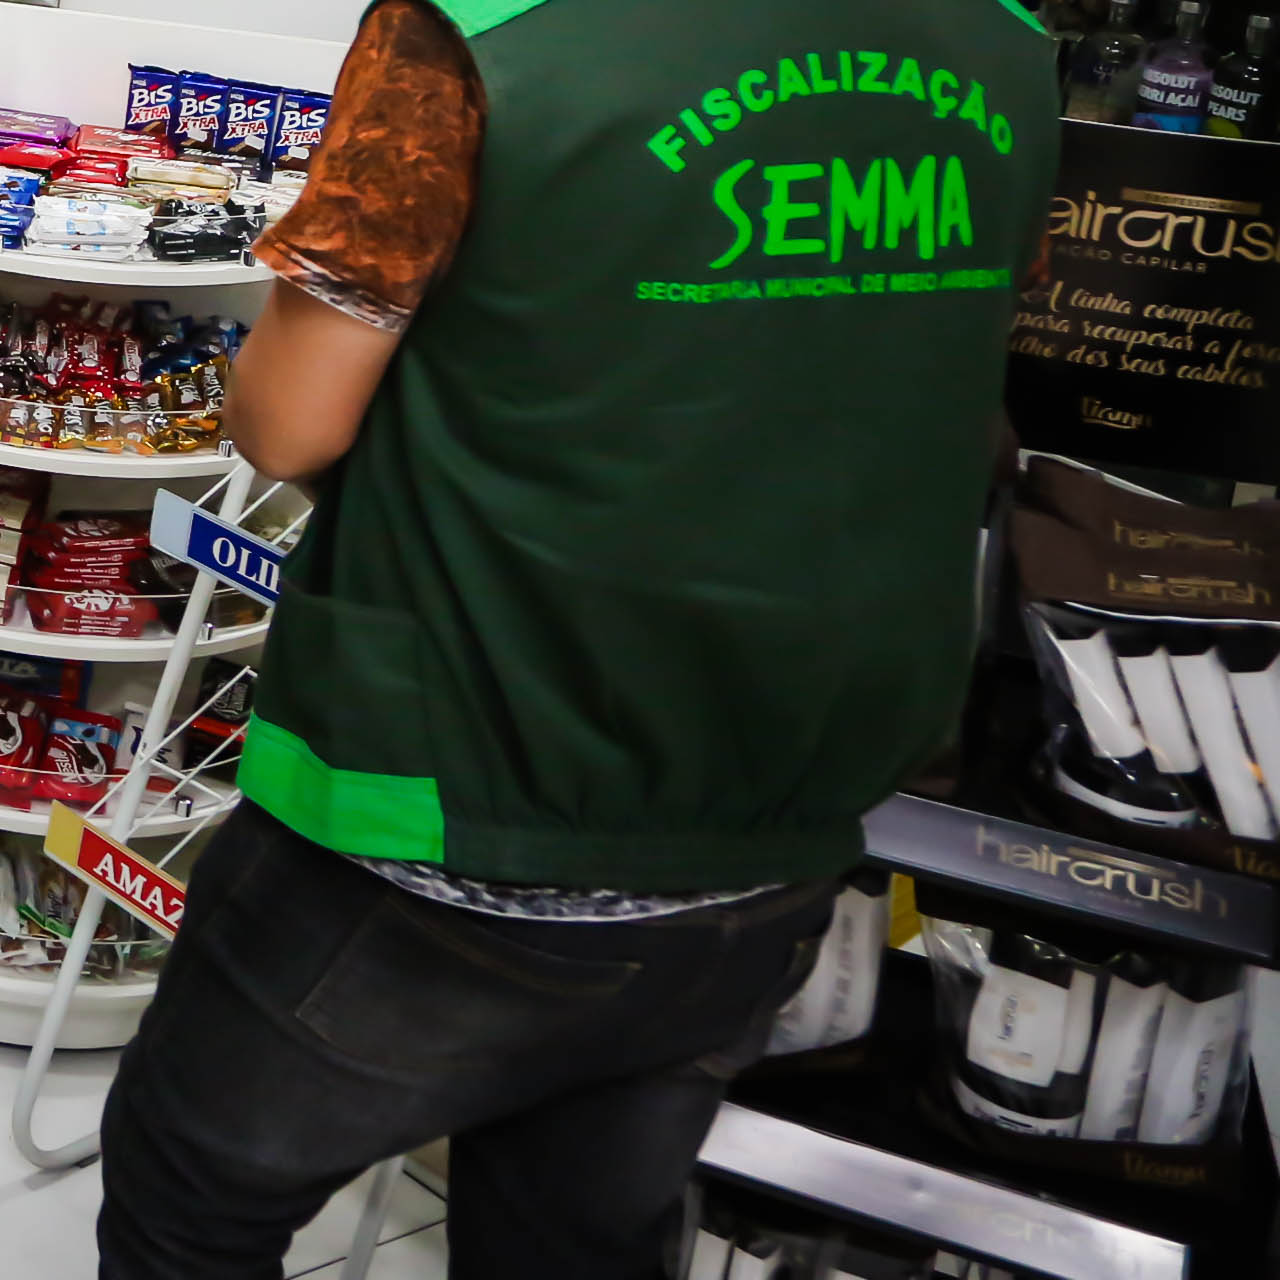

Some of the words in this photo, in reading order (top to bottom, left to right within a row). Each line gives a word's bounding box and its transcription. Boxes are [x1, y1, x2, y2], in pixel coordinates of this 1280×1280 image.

[1210, 82, 1261, 106] BSOLUT
[127, 105, 171, 125] XTRA
[646, 51, 1014, 174] FISCALIZAÇÃO
[1207, 100, 1248, 122] PEARS
[175, 115, 219, 134] XTRA
[224, 119, 268, 139] XTRA
[276, 128, 322, 147] XTRA
[708, 154, 974, 270] SEMMA
[1048, 190, 1280, 262] aircrus
[1120, 252, 1208, 273] CAPILAR
[635, 280, 762, 304] SECRETARIA
[860, 273, 888, 294] DE
[1070, 287, 1132, 315] linha
[1066, 344, 1109, 368] dos
[975, 825, 1228, 918] haircrush
